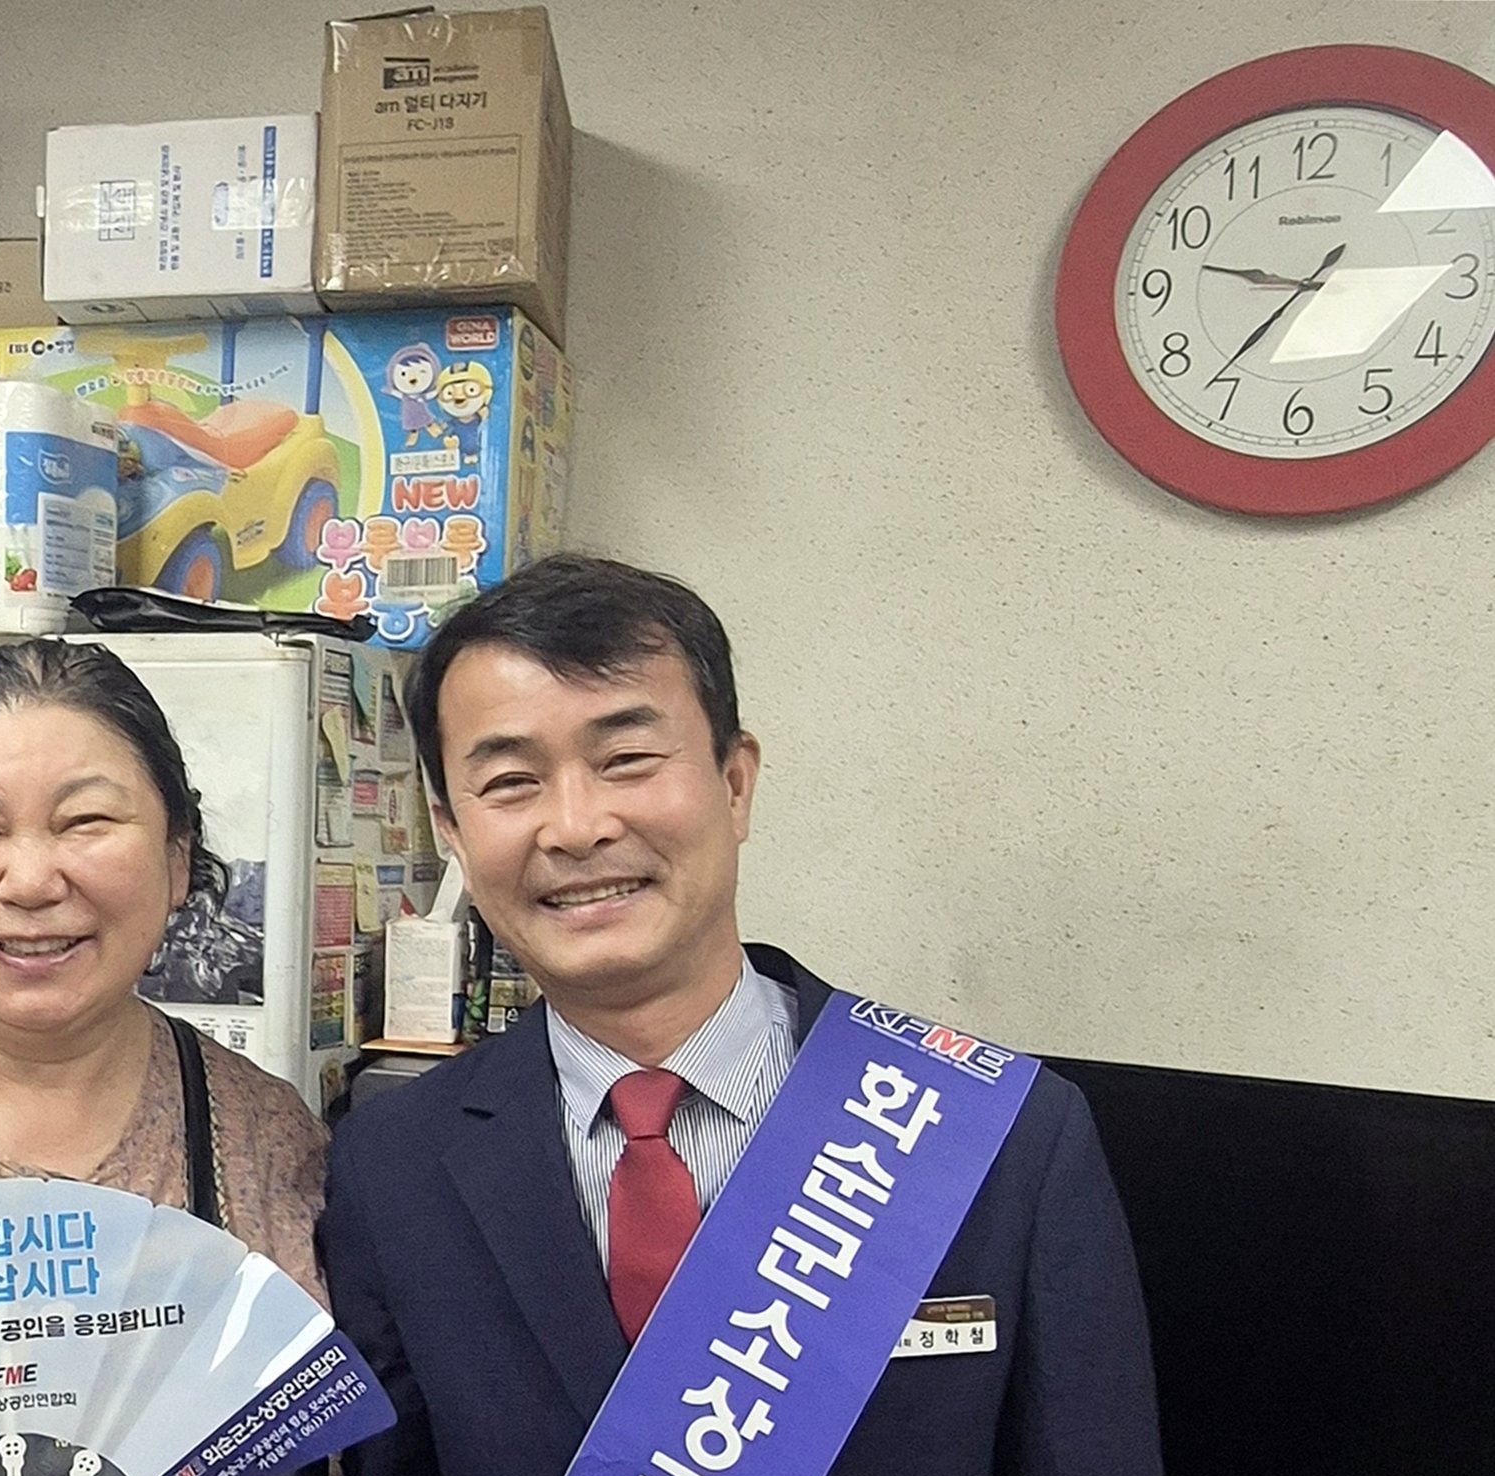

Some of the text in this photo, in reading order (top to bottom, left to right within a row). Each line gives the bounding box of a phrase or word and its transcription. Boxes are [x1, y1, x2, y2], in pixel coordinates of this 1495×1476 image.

[374, 92, 488, 114] am 멀티 다지기
[1223, 156, 1261, 200] 11
[1292, 132, 1339, 181] 12
[1379, 141, 1393, 187] 1
[1167, 205, 1212, 250] 10
[1141, 268, 1173, 316] 9
[1445, 253, 1480, 299] 3
[450, 332, 496, 345] WORLD
[1159, 332, 1191, 377] 8
[1414, 319, 1448, 366] 4
[1211, 377, 1241, 421] 7
[1282, 387, 1315, 436] 6
[1357, 368, 1394, 415] 5
[391, 475, 480, 512] NEW
[849, 998, 1015, 1081] KFME
[72, 1303, 186, 1336] 응원합니다
[200, 1345, 348, 1466] 화순군소상공인연합회
